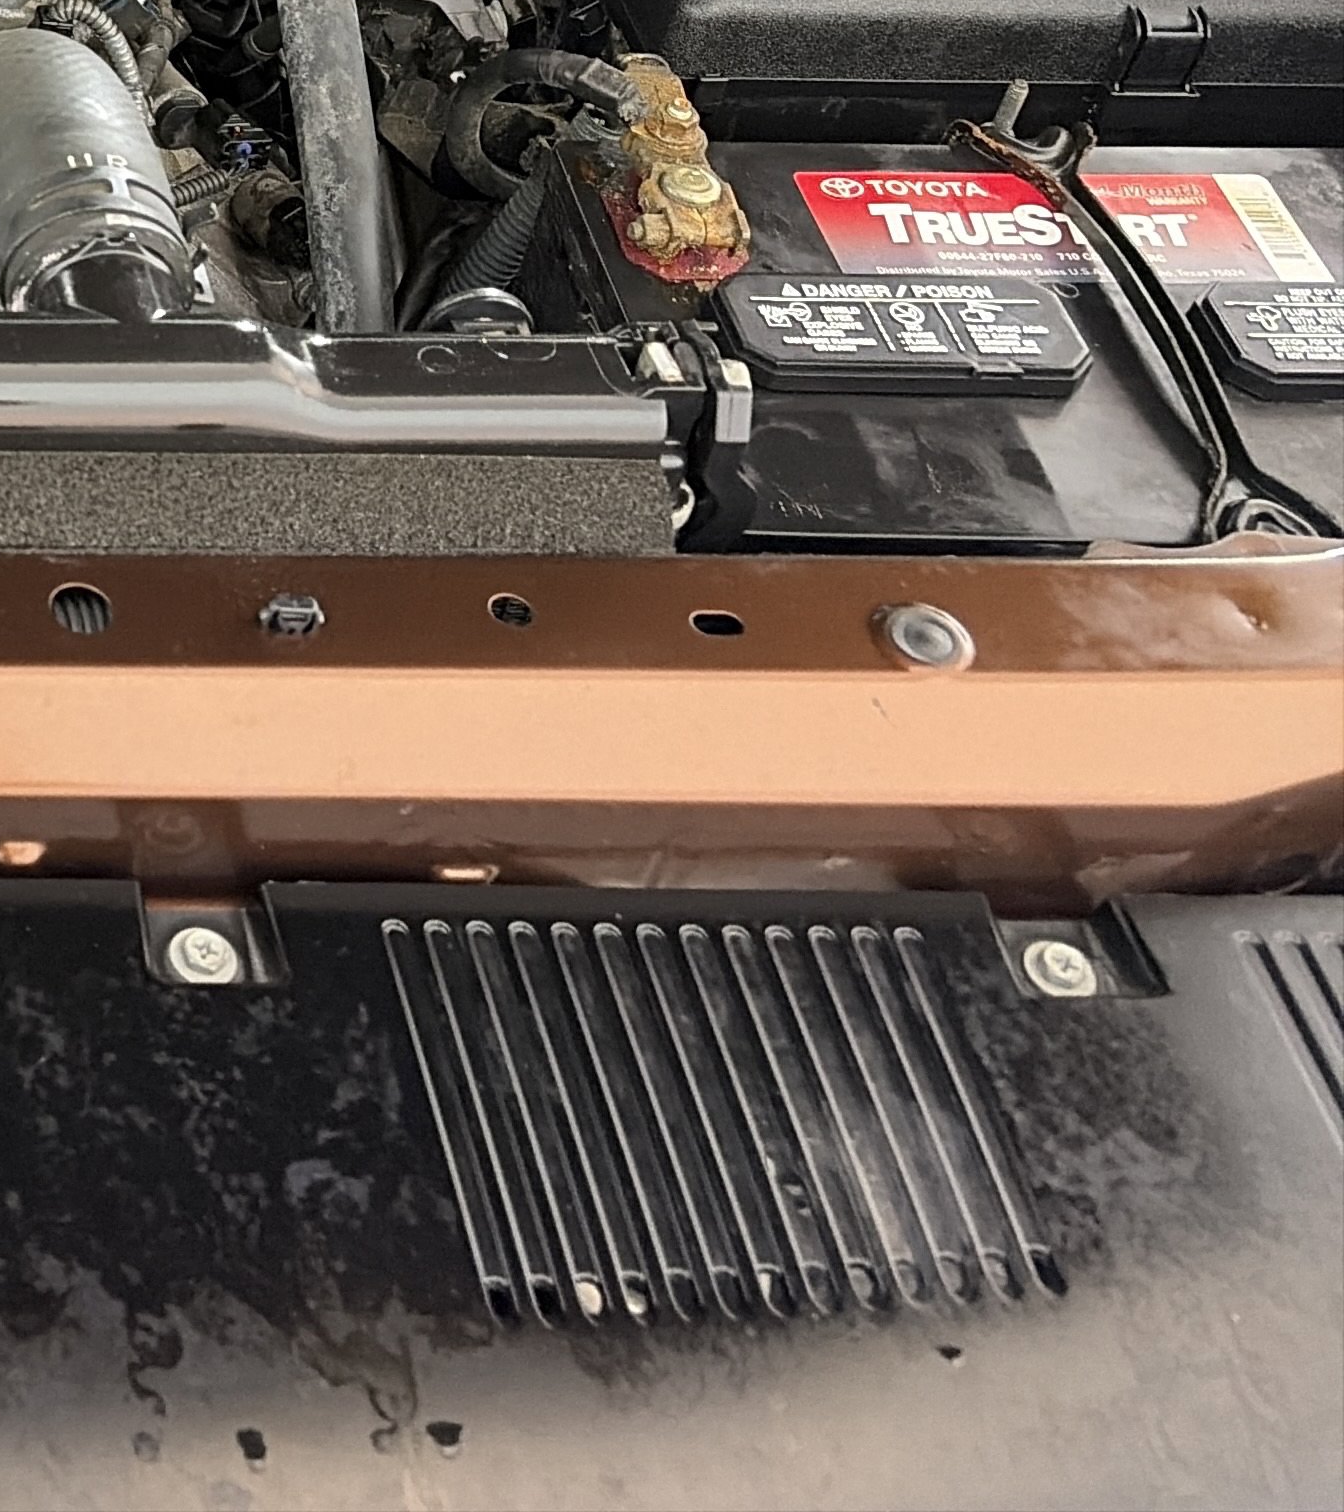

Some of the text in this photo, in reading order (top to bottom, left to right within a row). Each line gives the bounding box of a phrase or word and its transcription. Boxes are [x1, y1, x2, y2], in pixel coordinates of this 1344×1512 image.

[864, 179, 988, 198] TOYOTA
[867, 203, 1188, 248] TRUESTRT
[1056, 251, 1081, 262] 710
[801, 283, 893, 298] DANGER
[912, 284, 995, 299] POISON
